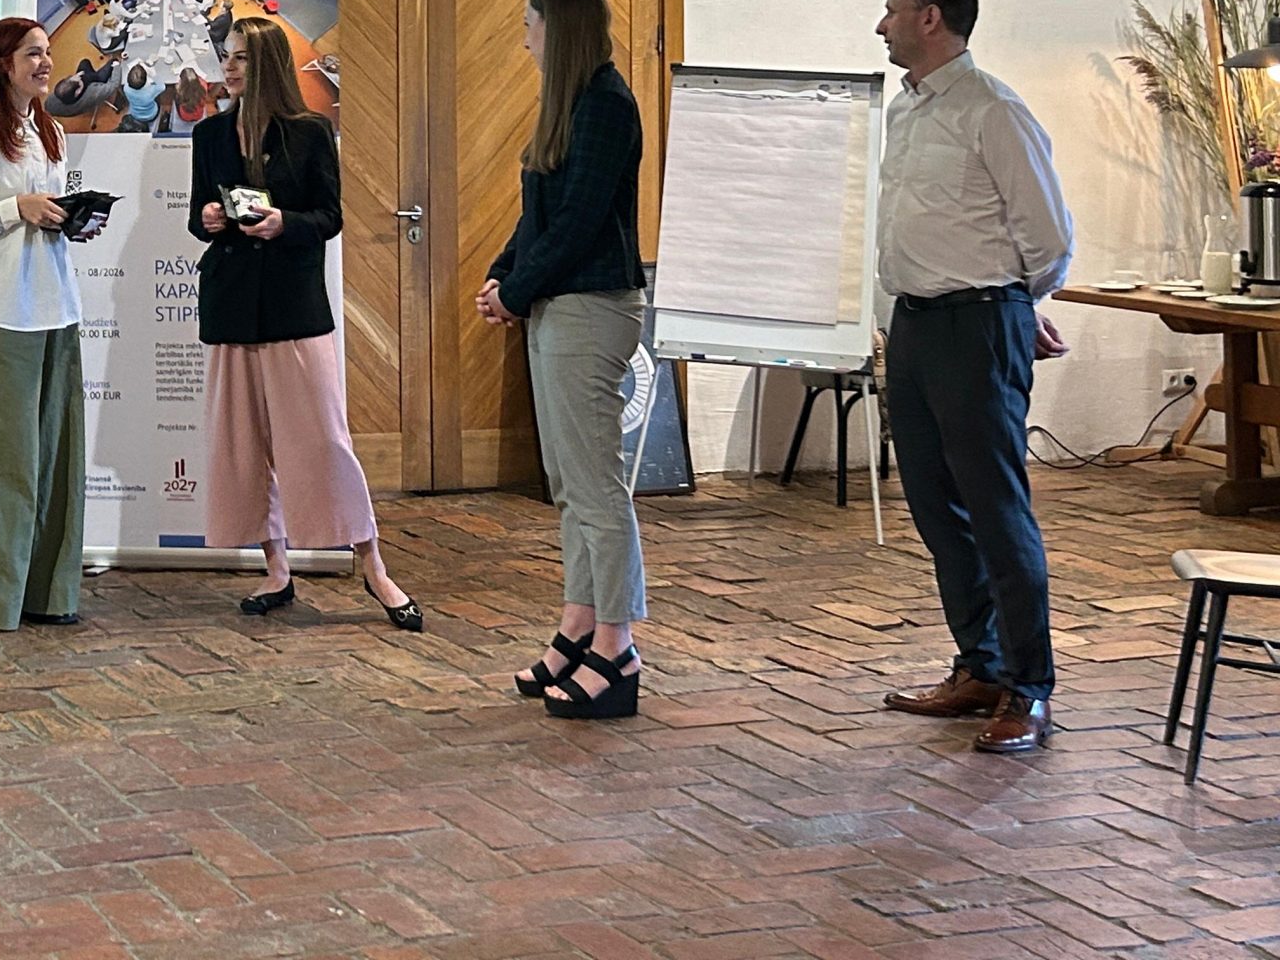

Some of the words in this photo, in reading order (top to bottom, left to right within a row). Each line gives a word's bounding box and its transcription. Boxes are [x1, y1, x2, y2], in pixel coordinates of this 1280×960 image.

[87, 268, 125, 277] 08/2026
[83, 318, 118, 327] budžets
[102, 330, 120, 339] EUR
[103, 391, 121, 400] EUR
[164, 479, 197, 493] 2027
